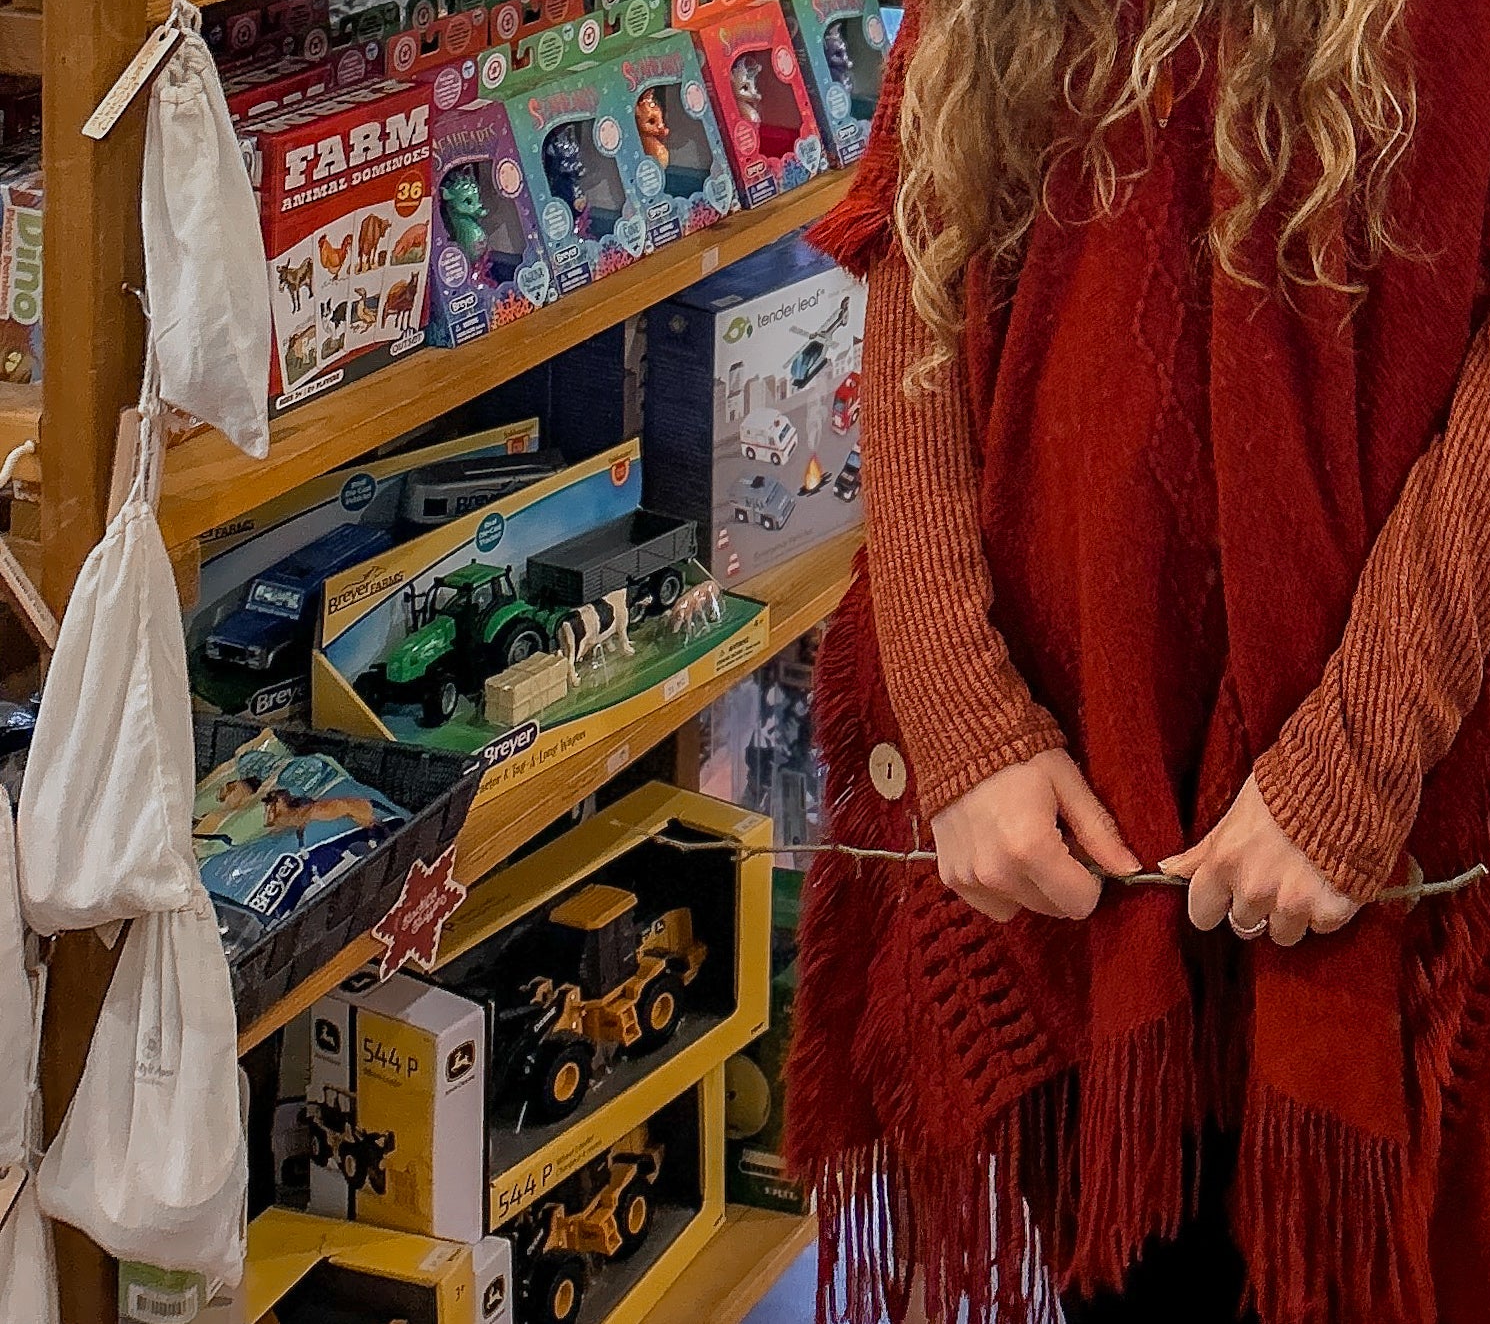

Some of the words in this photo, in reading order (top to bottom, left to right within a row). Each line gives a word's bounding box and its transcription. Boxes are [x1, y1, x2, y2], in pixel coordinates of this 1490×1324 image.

[284, 103, 430, 192] FARM
[280, 174, 349, 212] ANIMAL
[351, 146, 430, 186] DOMINOES
[397, 181, 424, 201] 36
[757, 302, 797, 328] tender
[328, 581, 371, 616] Breyer
[370, 570, 405, 595] FARMS
[483, 725, 535, 767] Breyer
[250, 856, 299, 913] Breyer
[362, 1036, 401, 1074] 544
[407, 1056, 418, 1078] P
[498, 1173, 537, 1219] 544
[542, 1162, 553, 1187] P
